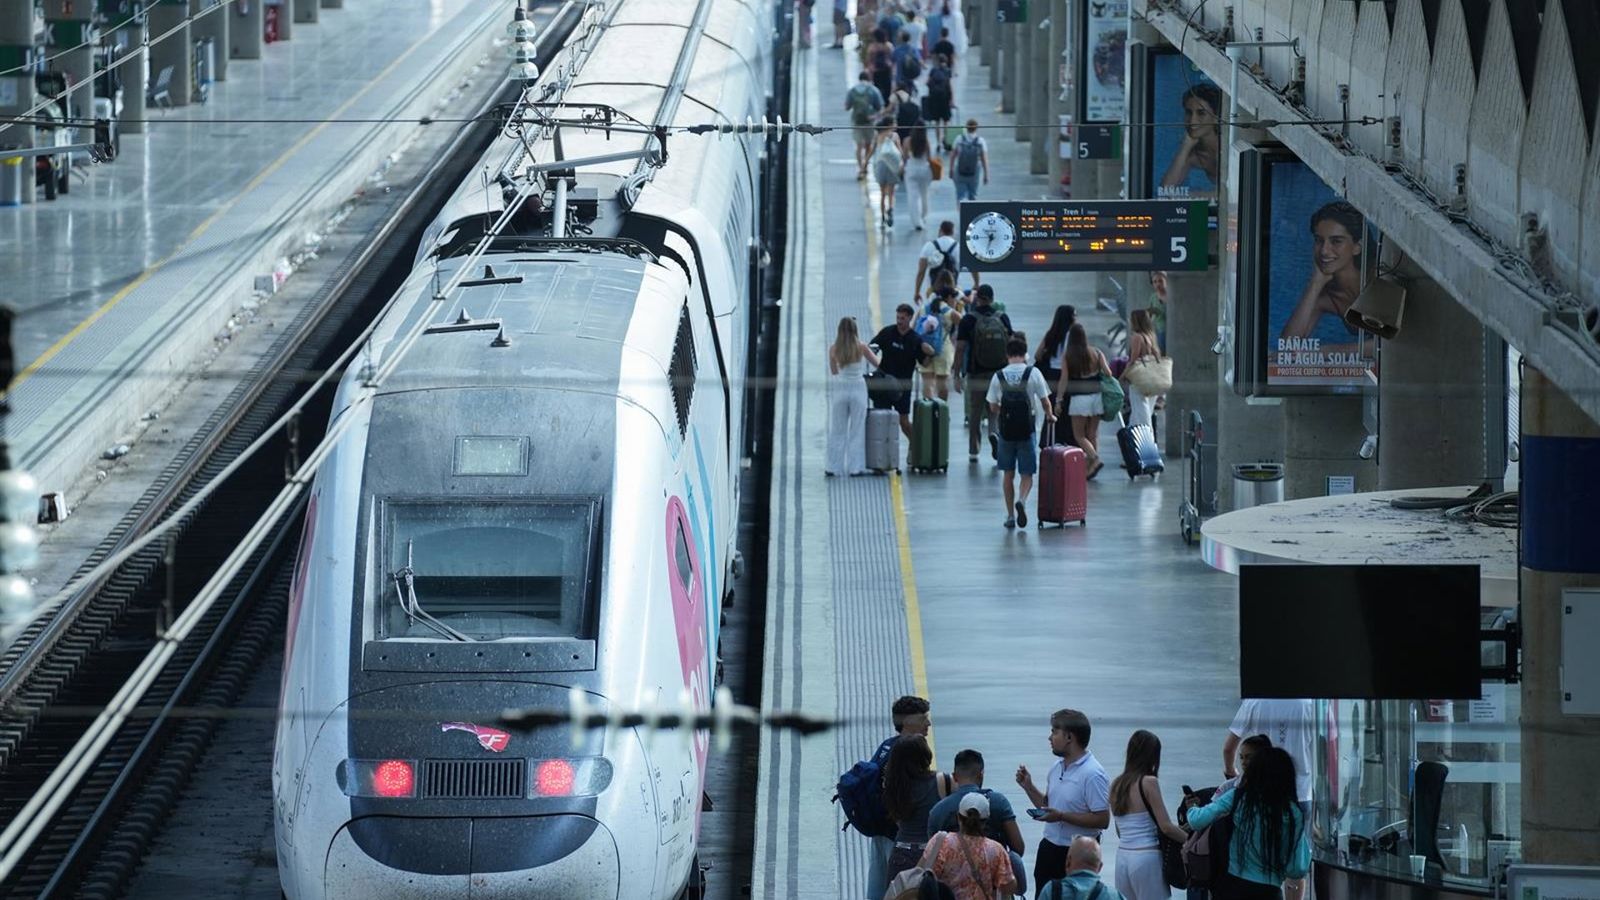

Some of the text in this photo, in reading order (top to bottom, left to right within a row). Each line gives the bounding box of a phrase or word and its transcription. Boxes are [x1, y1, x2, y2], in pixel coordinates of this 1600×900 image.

[997, 10, 1006, 22] 5
[1079, 142, 1089, 158] 5
[1021, 208, 1038, 216] Hora
[1021, 230, 1048, 238] Destino
[1171, 236, 1187, 262] 5
[1277, 352, 1292, 365] EN
[1295, 352, 1325, 365] AGUA
